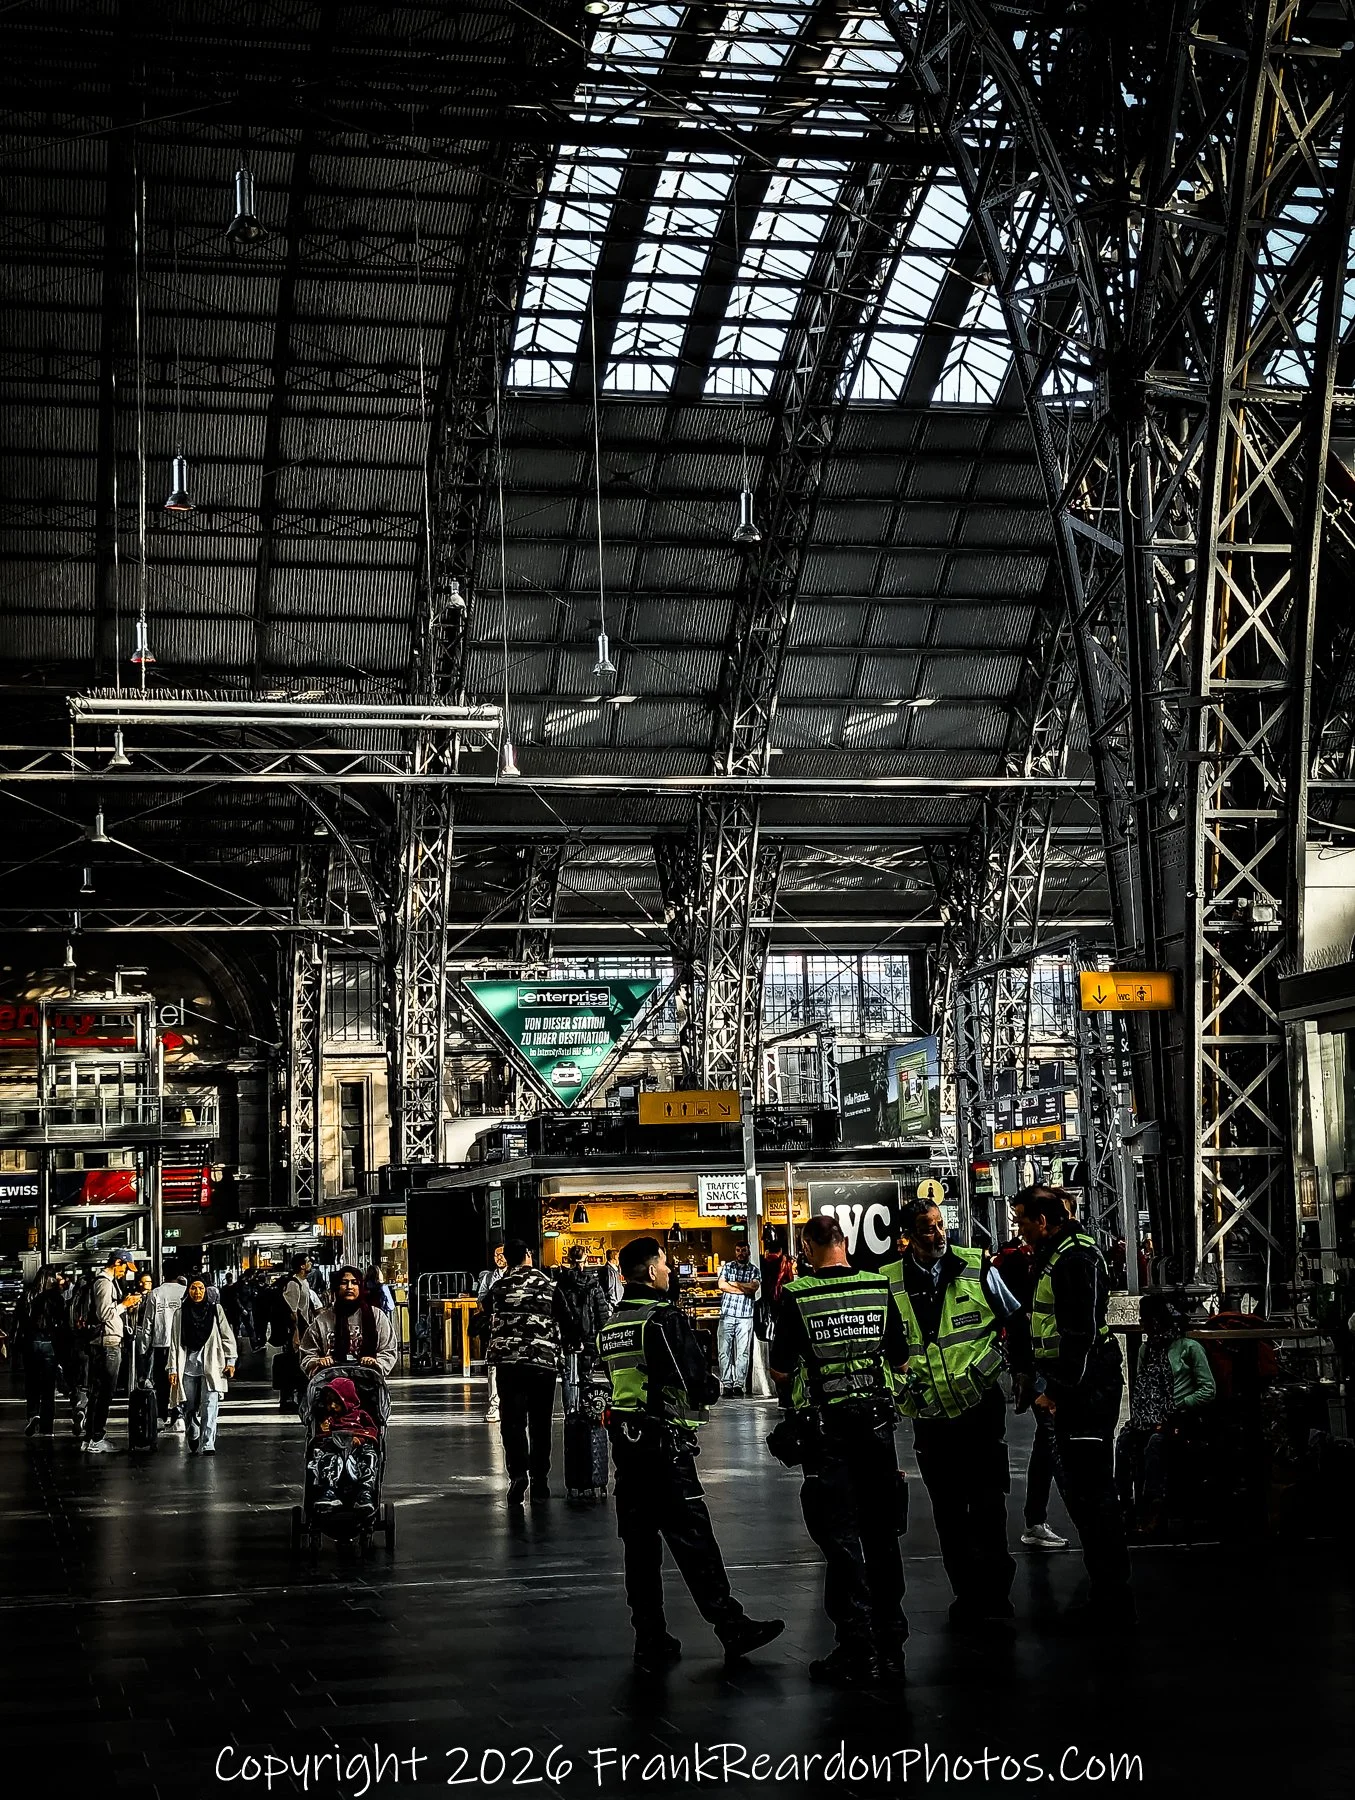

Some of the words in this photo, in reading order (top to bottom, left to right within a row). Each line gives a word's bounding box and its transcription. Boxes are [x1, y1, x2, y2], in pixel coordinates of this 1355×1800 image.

[519, 990, 609, 1005] enterprise
[1117, 993, 1131, 1001] WC
[524, 1017, 541, 1031] VON
[542, 1016, 571, 1030] DIESER
[572, 1016, 606, 1030] STATION
[520, 1032, 532, 1046] ZU
[532, 1032, 557, 1045] IHRER
[558, 1030, 610, 1045] DESTINATION
[1066, 1161, 1078, 1182] 7
[706, 1182, 740, 1191] TRAFFIC
[706, 1190, 741, 1201] SNACK
[810, 1317, 824, 1329] Im
[826, 1314, 865, 1327] Auftrag
[866, 1312, 882, 1323] der
[815, 1329, 831, 1341] DB
[833, 1324, 880, 1339] Sicherheit
